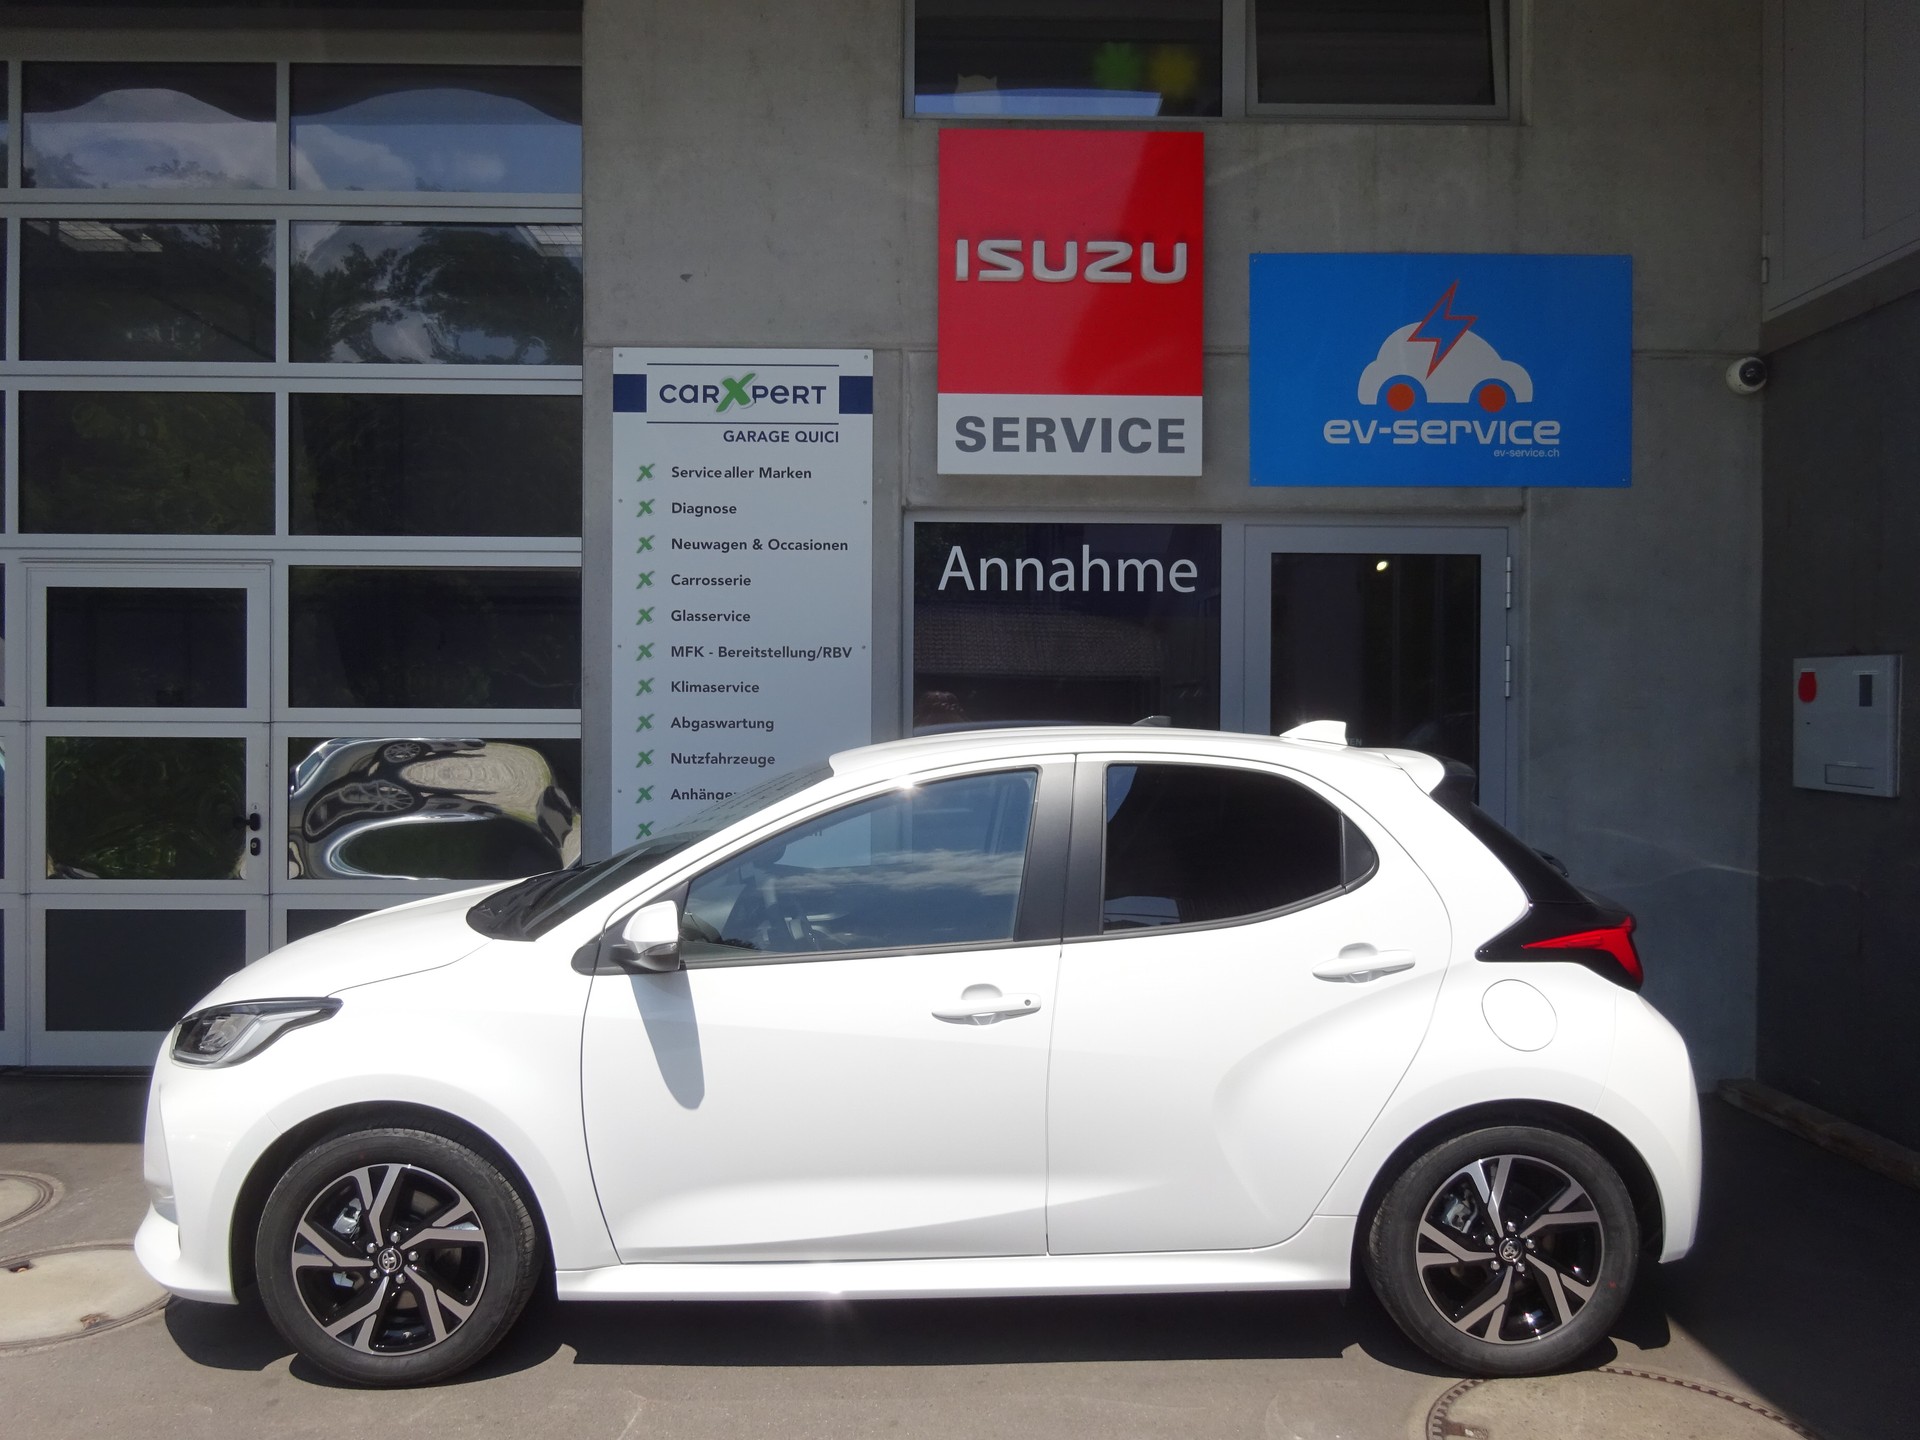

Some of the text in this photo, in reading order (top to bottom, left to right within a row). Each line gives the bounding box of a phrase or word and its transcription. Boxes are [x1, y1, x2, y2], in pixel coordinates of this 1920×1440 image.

[955, 239, 1188, 284] ISUZU
[724, 430, 838, 443] GARAGE QUICI
[955, 416, 1185, 453] SERVICE
[1324, 420, 1560, 444] ev-service
[1493, 447, 1560, 458] ev-service.ch
[672, 466, 811, 478] Service aller Marken
[672, 503, 736, 517] Diagnose
[672, 539, 847, 553] Neuwagen & Occasionen
[938, 545, 1197, 592] Annahme
[671, 574, 751, 586] Carrosserie
[671, 610, 750, 621] Glasservice
[672, 646, 704, 657] MFK
[719, 646, 852, 661] Bereitstellung/RBV
[672, 681, 759, 692] Klimaservice
[671, 717, 773, 732] Abgaswartung
[671, 752, 775, 767] Nutzfahrzeuge
[671, 788, 736, 803] Anhänge
